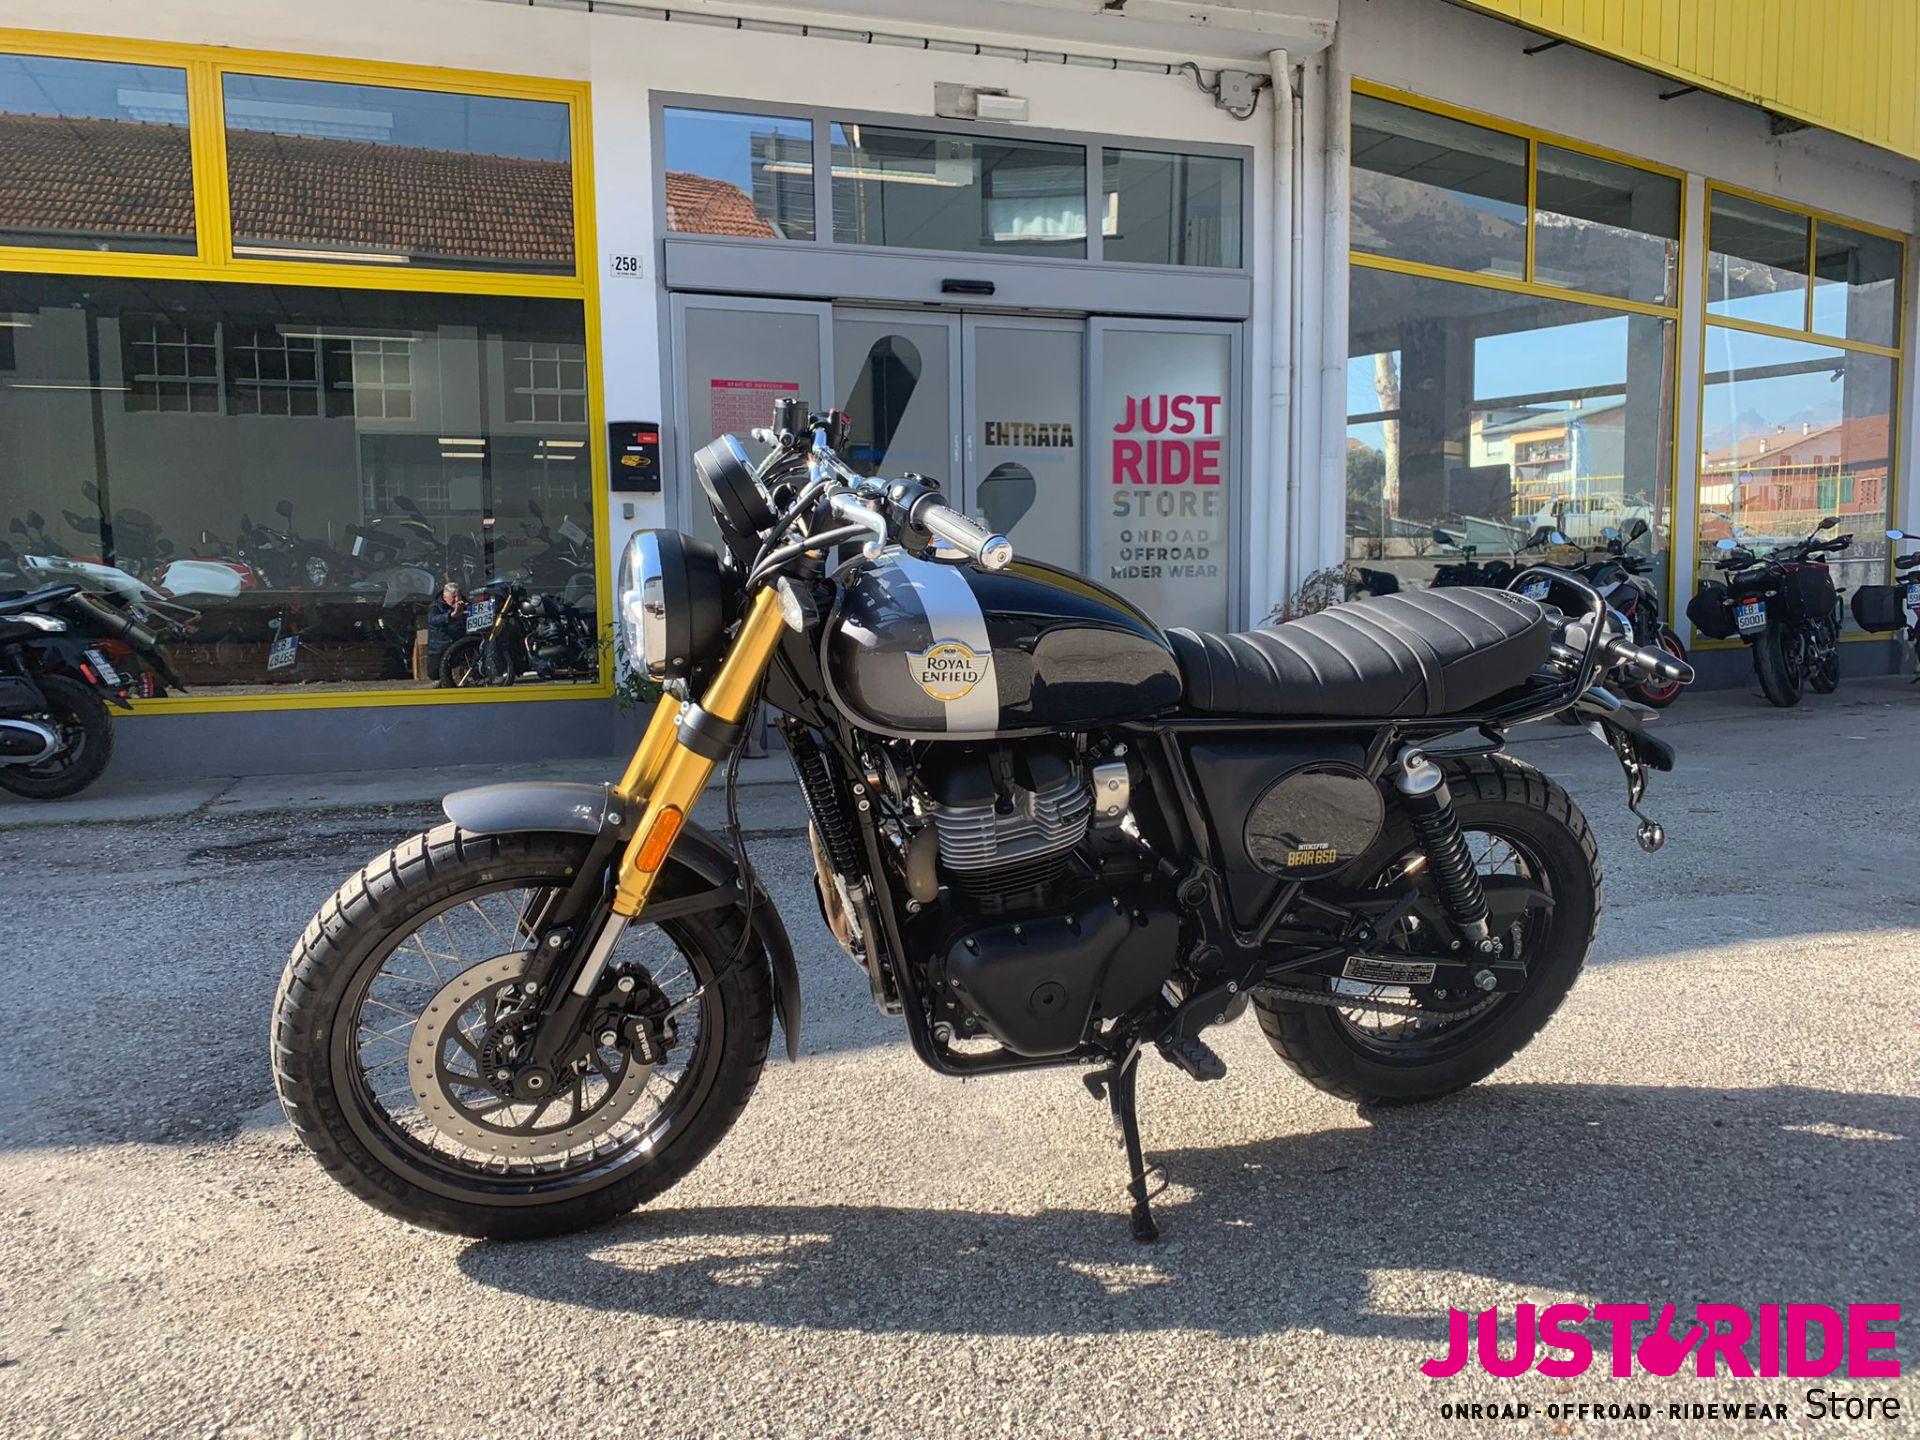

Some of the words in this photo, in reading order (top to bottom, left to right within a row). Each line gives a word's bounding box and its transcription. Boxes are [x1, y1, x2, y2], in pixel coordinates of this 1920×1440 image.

[615, 256, 637, 271] 258
[1112, 394, 1221, 435] JUST
[985, 421, 1074, 447] ENTRATA
[1112, 440, 1220, 485] RIDE
[1112, 490, 1219, 517] STORE
[1120, 530, 1209, 543] ONROAD
[1119, 547, 1209, 561] OFFROAD
[1111, 565, 1162, 579] RIDER
[1168, 565, 1217, 578] WEAR
[927, 658, 973, 670] ROYAL
[922, 671, 978, 682] ENFIELD
[1287, 850, 1315, 867] BEAR
[1315, 849, 1337, 864] 650
